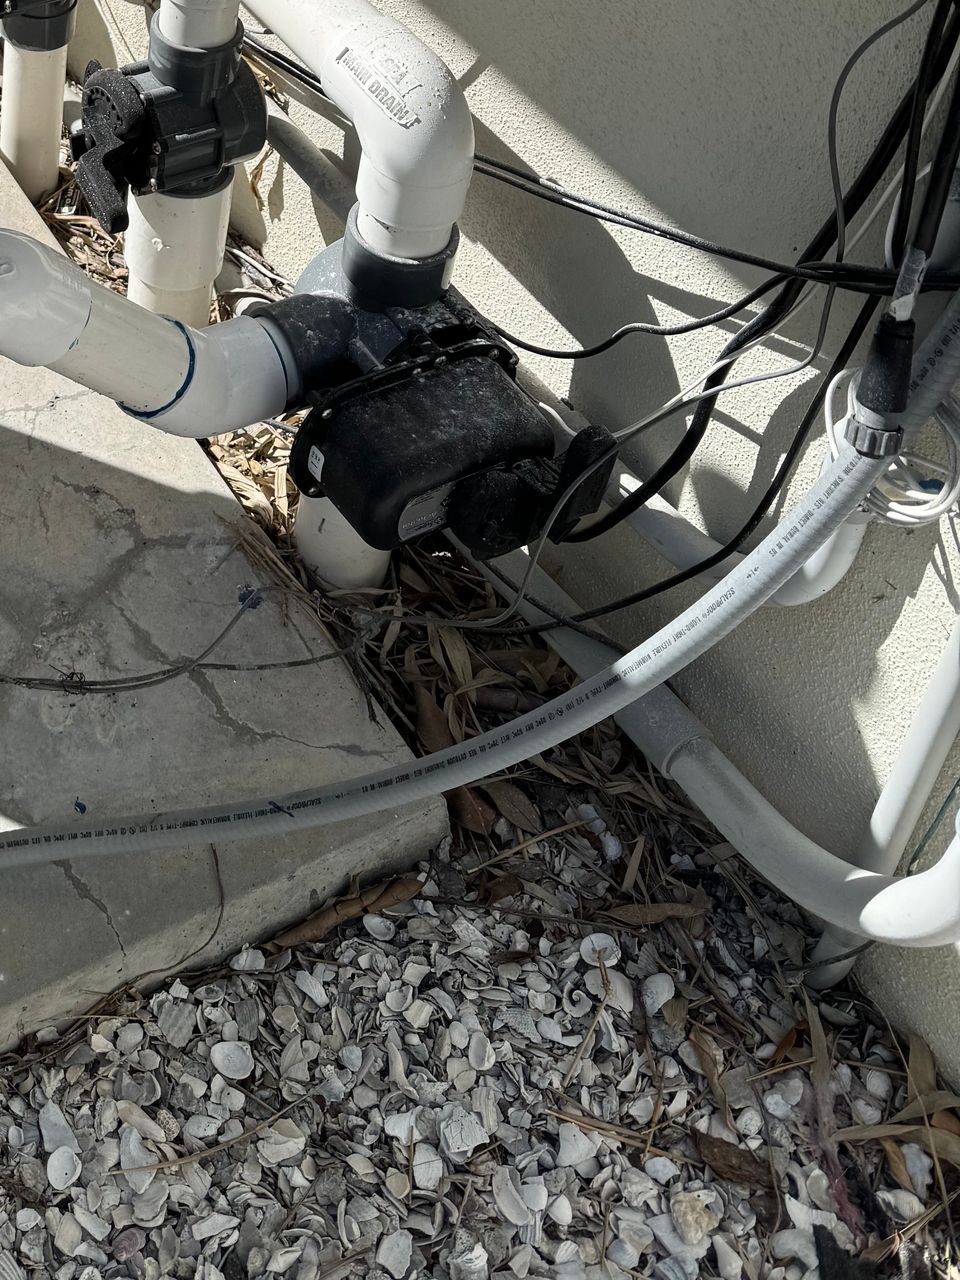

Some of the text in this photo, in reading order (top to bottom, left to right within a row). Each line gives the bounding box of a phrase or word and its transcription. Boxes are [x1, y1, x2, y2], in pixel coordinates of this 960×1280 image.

[342, 51, 373, 86] MAIN
[367, 79, 410, 122] DRAIN
[796, 508, 815, 528] DIRECT
